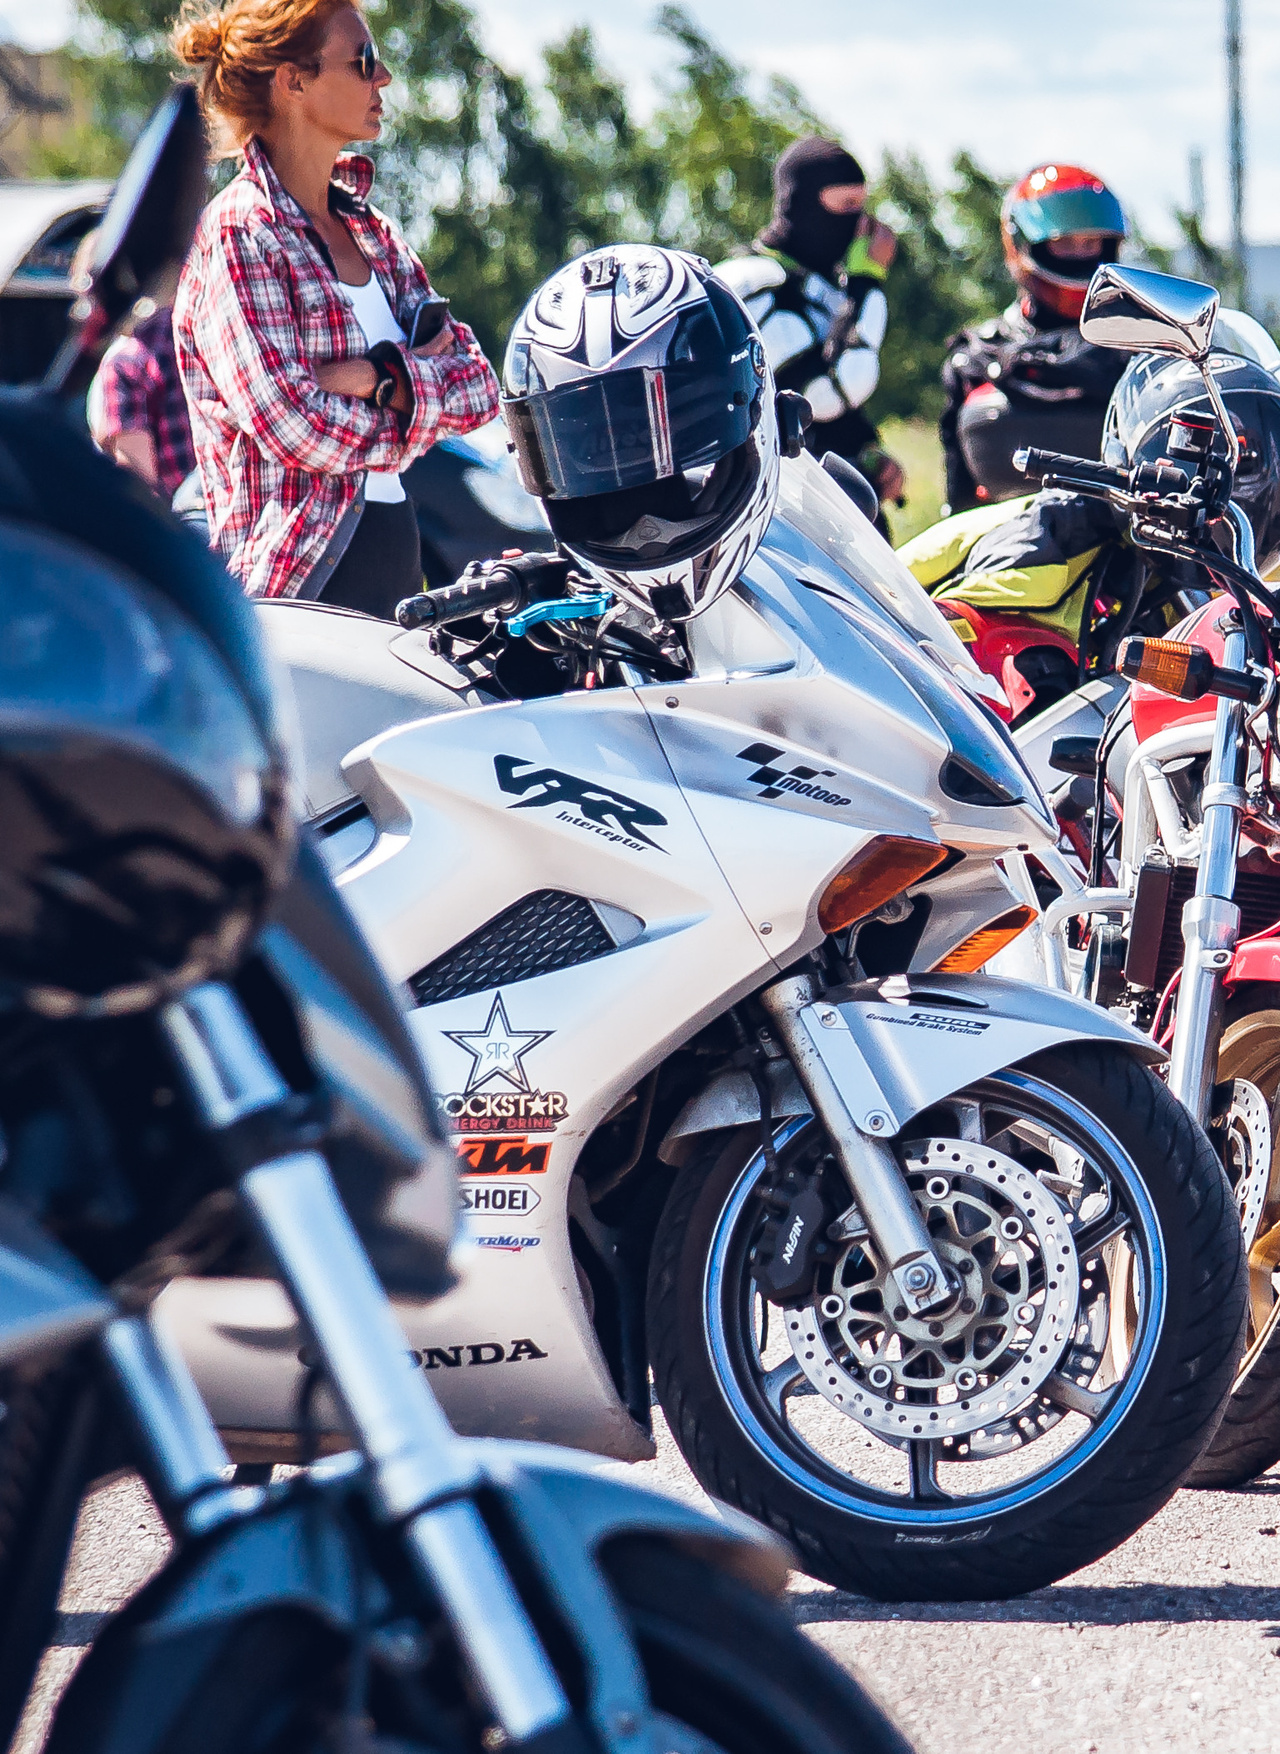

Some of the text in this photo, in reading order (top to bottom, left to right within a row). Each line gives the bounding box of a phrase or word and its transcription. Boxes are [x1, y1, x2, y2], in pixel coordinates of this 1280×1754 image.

[555, 810, 649, 852] Interceptor
[866, 1013, 983, 1036] Combined Brake System
